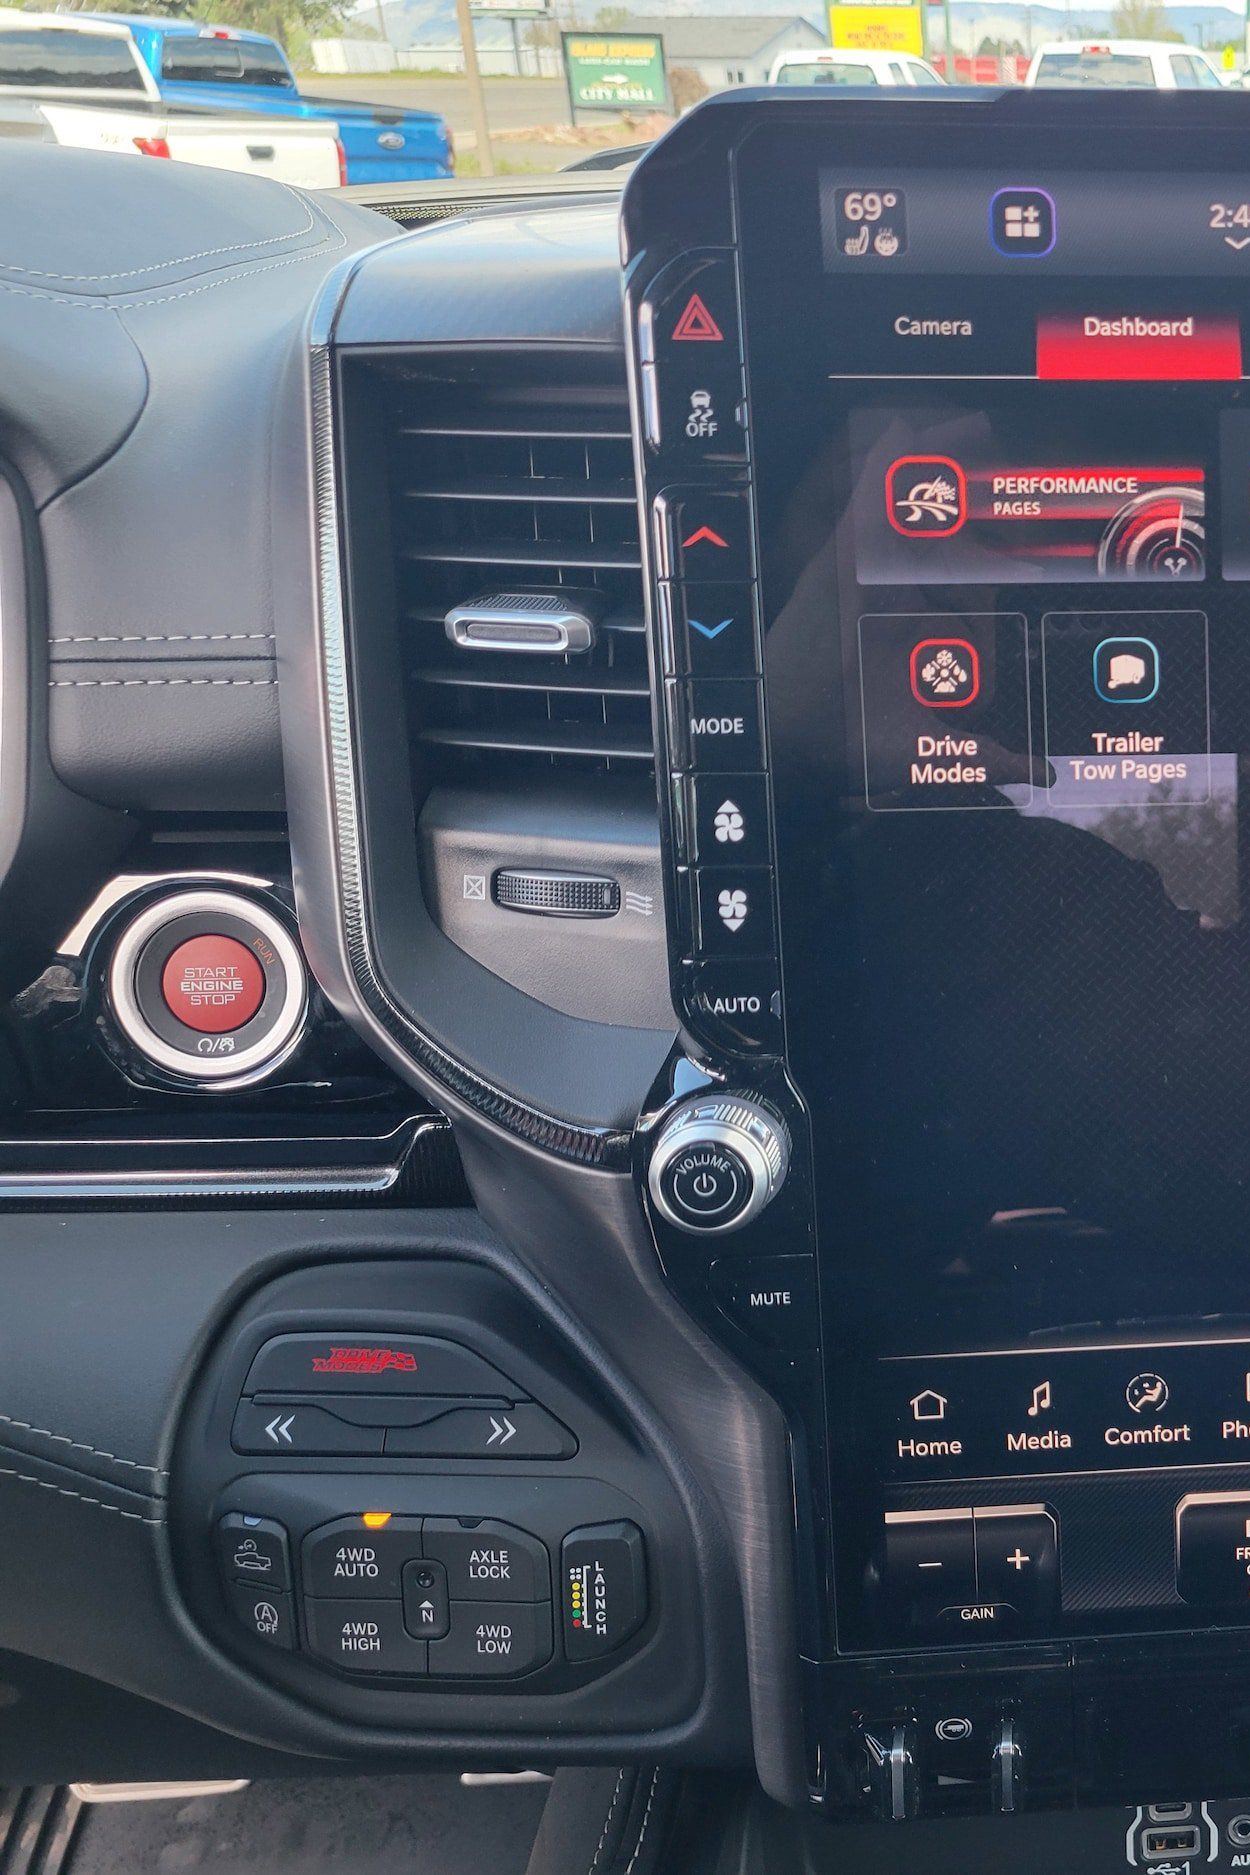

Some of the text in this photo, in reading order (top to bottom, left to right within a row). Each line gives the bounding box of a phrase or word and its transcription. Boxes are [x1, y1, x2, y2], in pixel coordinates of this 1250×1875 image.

[894, 316, 972, 337] Camera
[1084, 316, 1193, 337] Dashboard
[685, 422, 718, 437] OFF
[993, 477, 1138, 494] PERFORMANCE
[993, 501, 1041, 516] PAGES
[691, 718, 744, 735] MODE
[917, 735, 978, 757] Drive
[1091, 732, 1164, 754] Trailer
[911, 763, 986, 785] Modes
[1070, 760, 1187, 783] Tow Pages
[253, 937, 275, 965] RUN
[184, 966, 238, 978] START
[180, 980, 244, 992] ENGINE
[190, 994, 236, 1006] STOP
[713, 998, 760, 1014] AUTO
[676, 1154, 731, 1175] VOLUME
[750, 1292, 791, 1306] MUTE
[1007, 1430, 1072, 1451] Media
[1104, 1424, 1191, 1446] Comfort
[898, 1439, 963, 1457] Home
[335, 1548, 376, 1562] 4WD
[469, 1550, 508, 1564] AXLE
[334, 1563, 379, 1577] AUTO
[469, 1565, 510, 1579] LOCK
[594, 1561, 607, 1634] LAUNCH
[421, 1609, 434, 1623] N
[960, 1607, 994, 1620] GAIN
[257, 1621, 278, 1634] OFF
[342, 1622, 378, 1636] 4WD
[476, 1624, 512, 1638] 4WD
[341, 1637, 381, 1651] HIGH
[476, 1639, 512, 1654] LOW
[1181, 1861, 1191, 1875] 1
